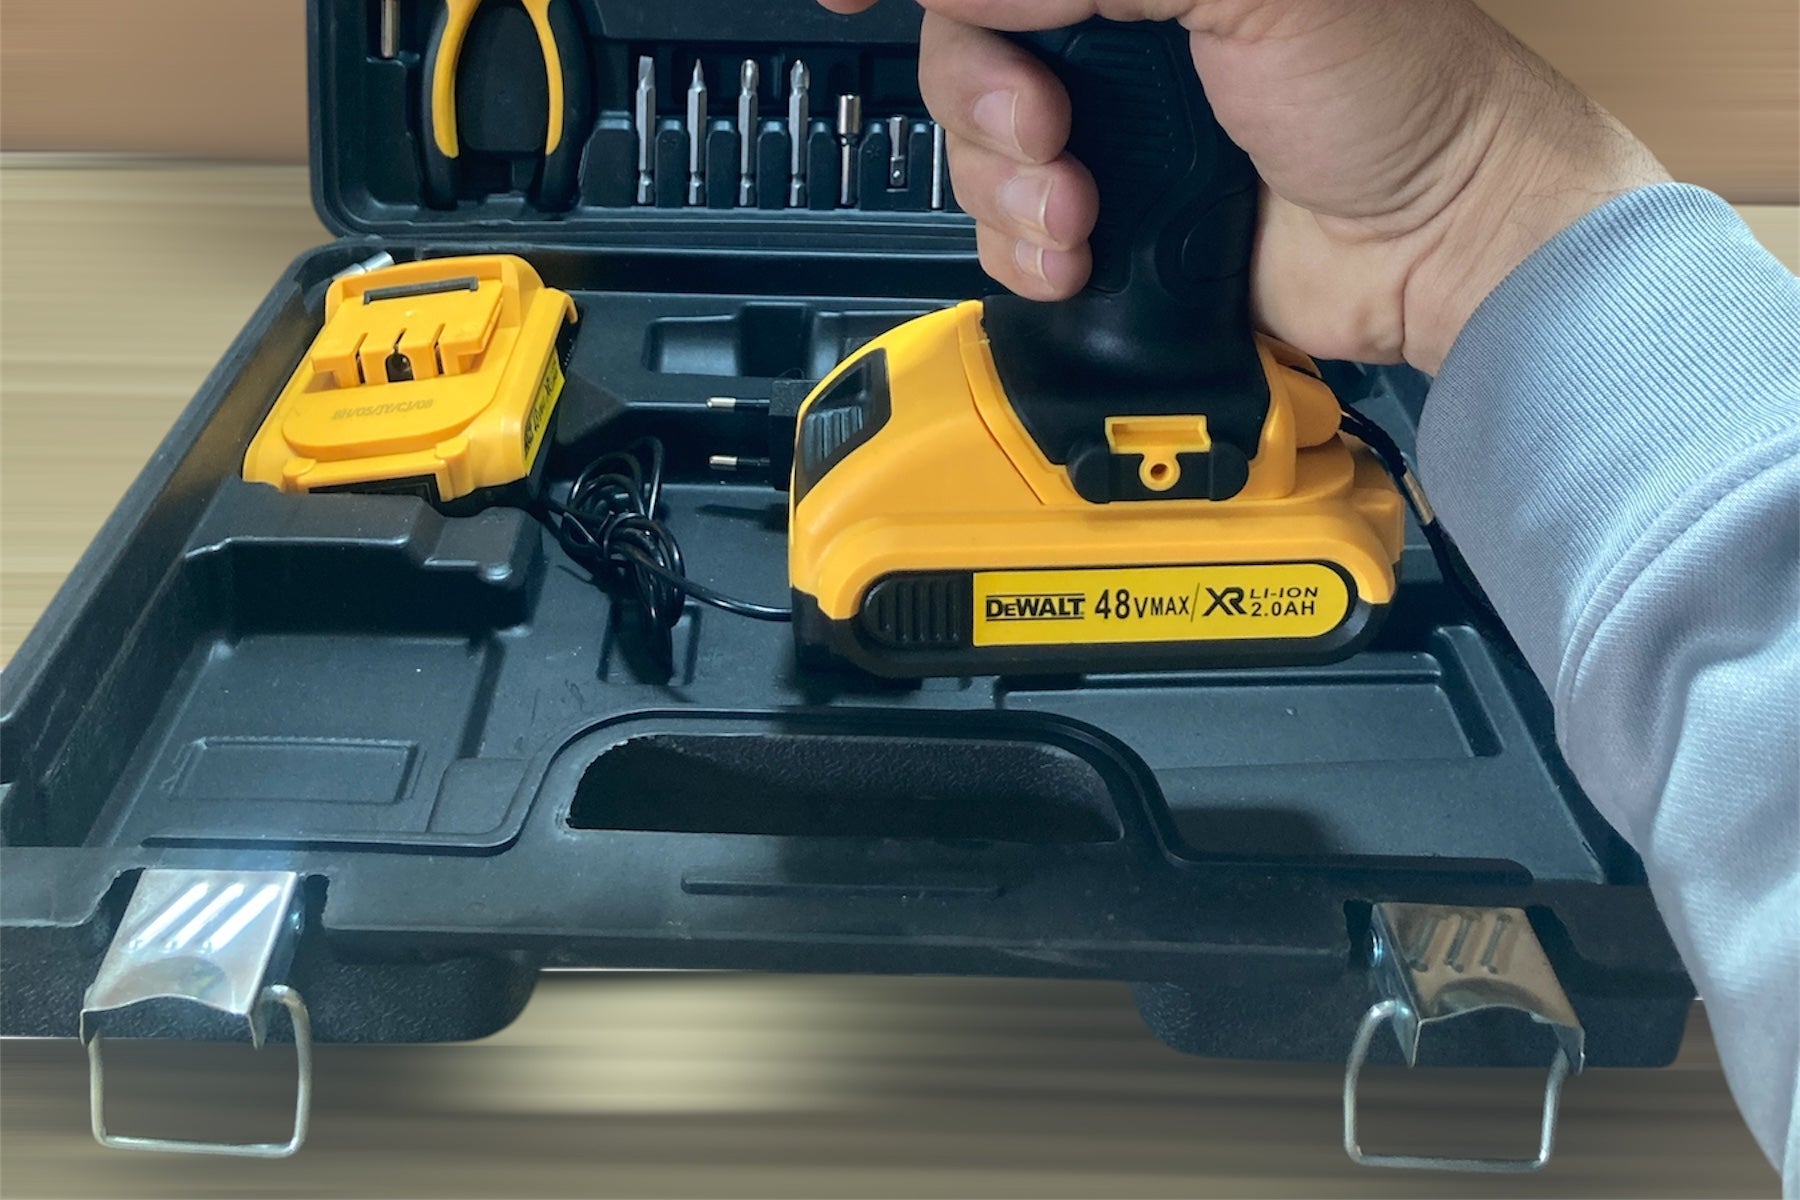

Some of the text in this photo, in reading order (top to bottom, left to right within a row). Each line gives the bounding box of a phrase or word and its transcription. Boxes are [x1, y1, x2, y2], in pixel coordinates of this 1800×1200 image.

[1250, 586, 1318, 599] LI-ION
[1203, 586, 1247, 617] XR
[1251, 601, 1315, 617] 2.0AH
